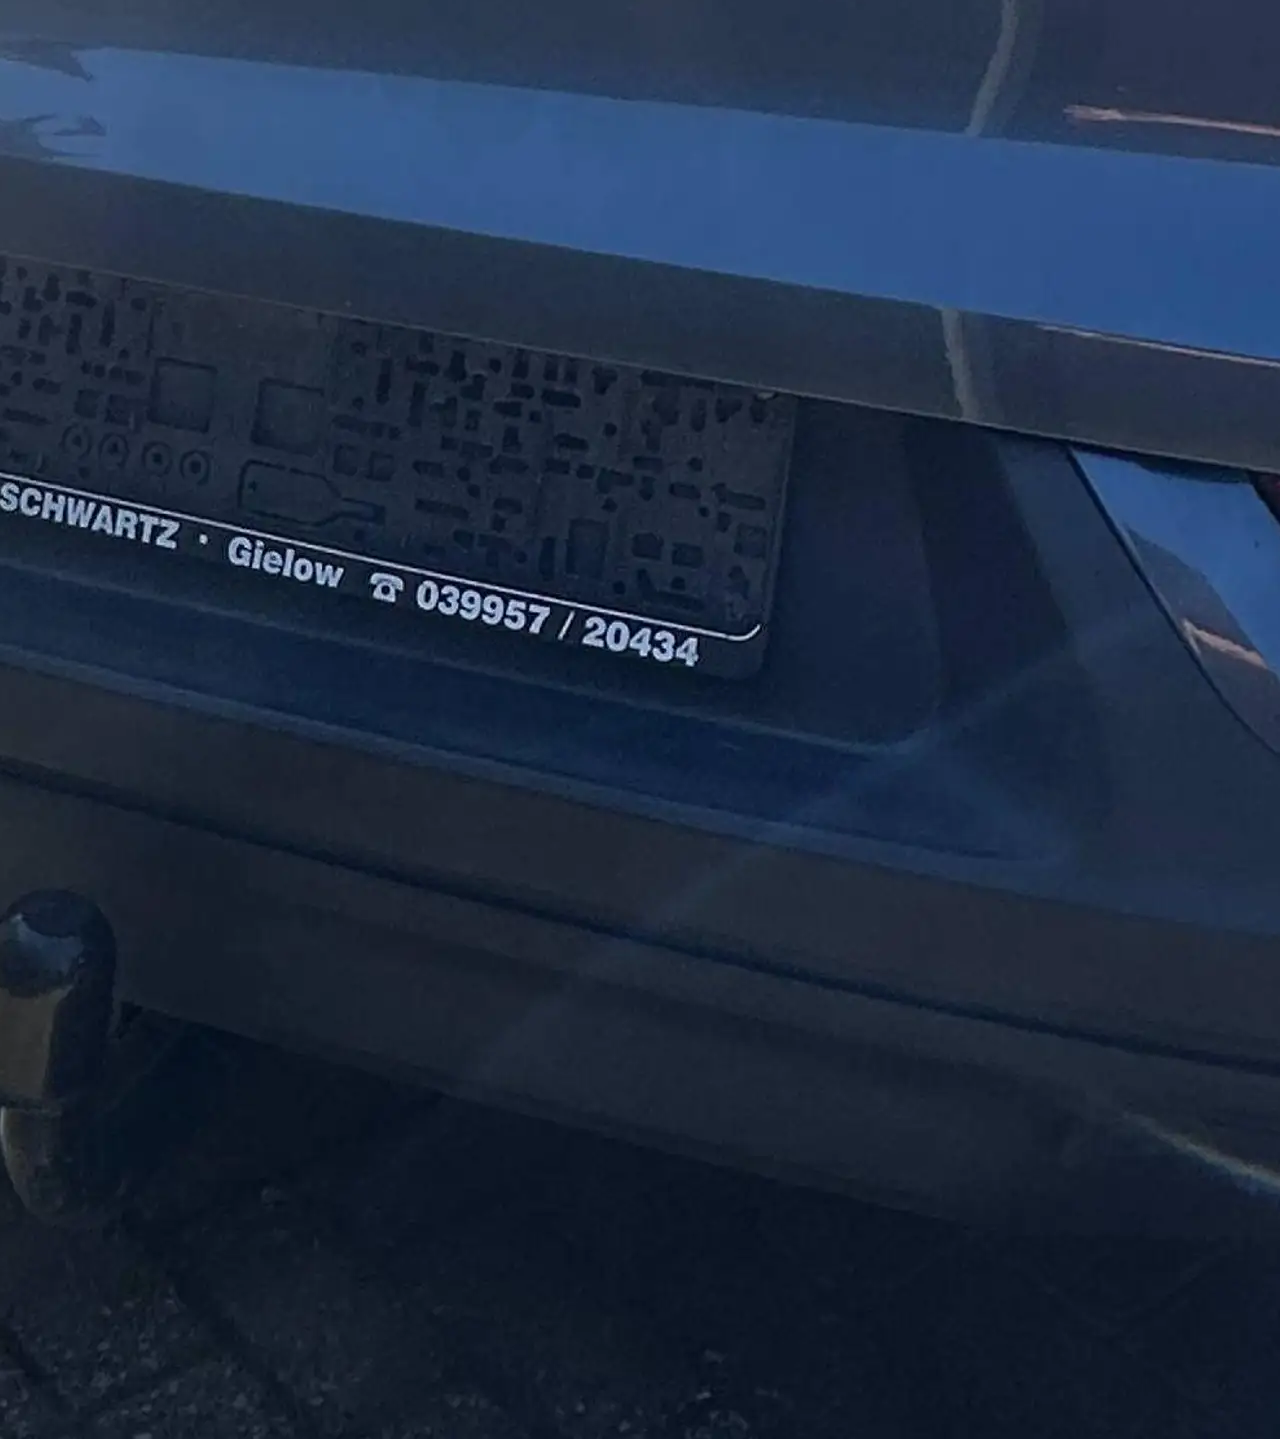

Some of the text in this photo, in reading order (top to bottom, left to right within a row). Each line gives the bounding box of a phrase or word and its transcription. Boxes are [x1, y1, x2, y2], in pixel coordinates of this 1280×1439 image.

[227, 536, 344, 588] Gielow
[416, 580, 551, 635] 039957
[582, 616, 699, 667] 20434
